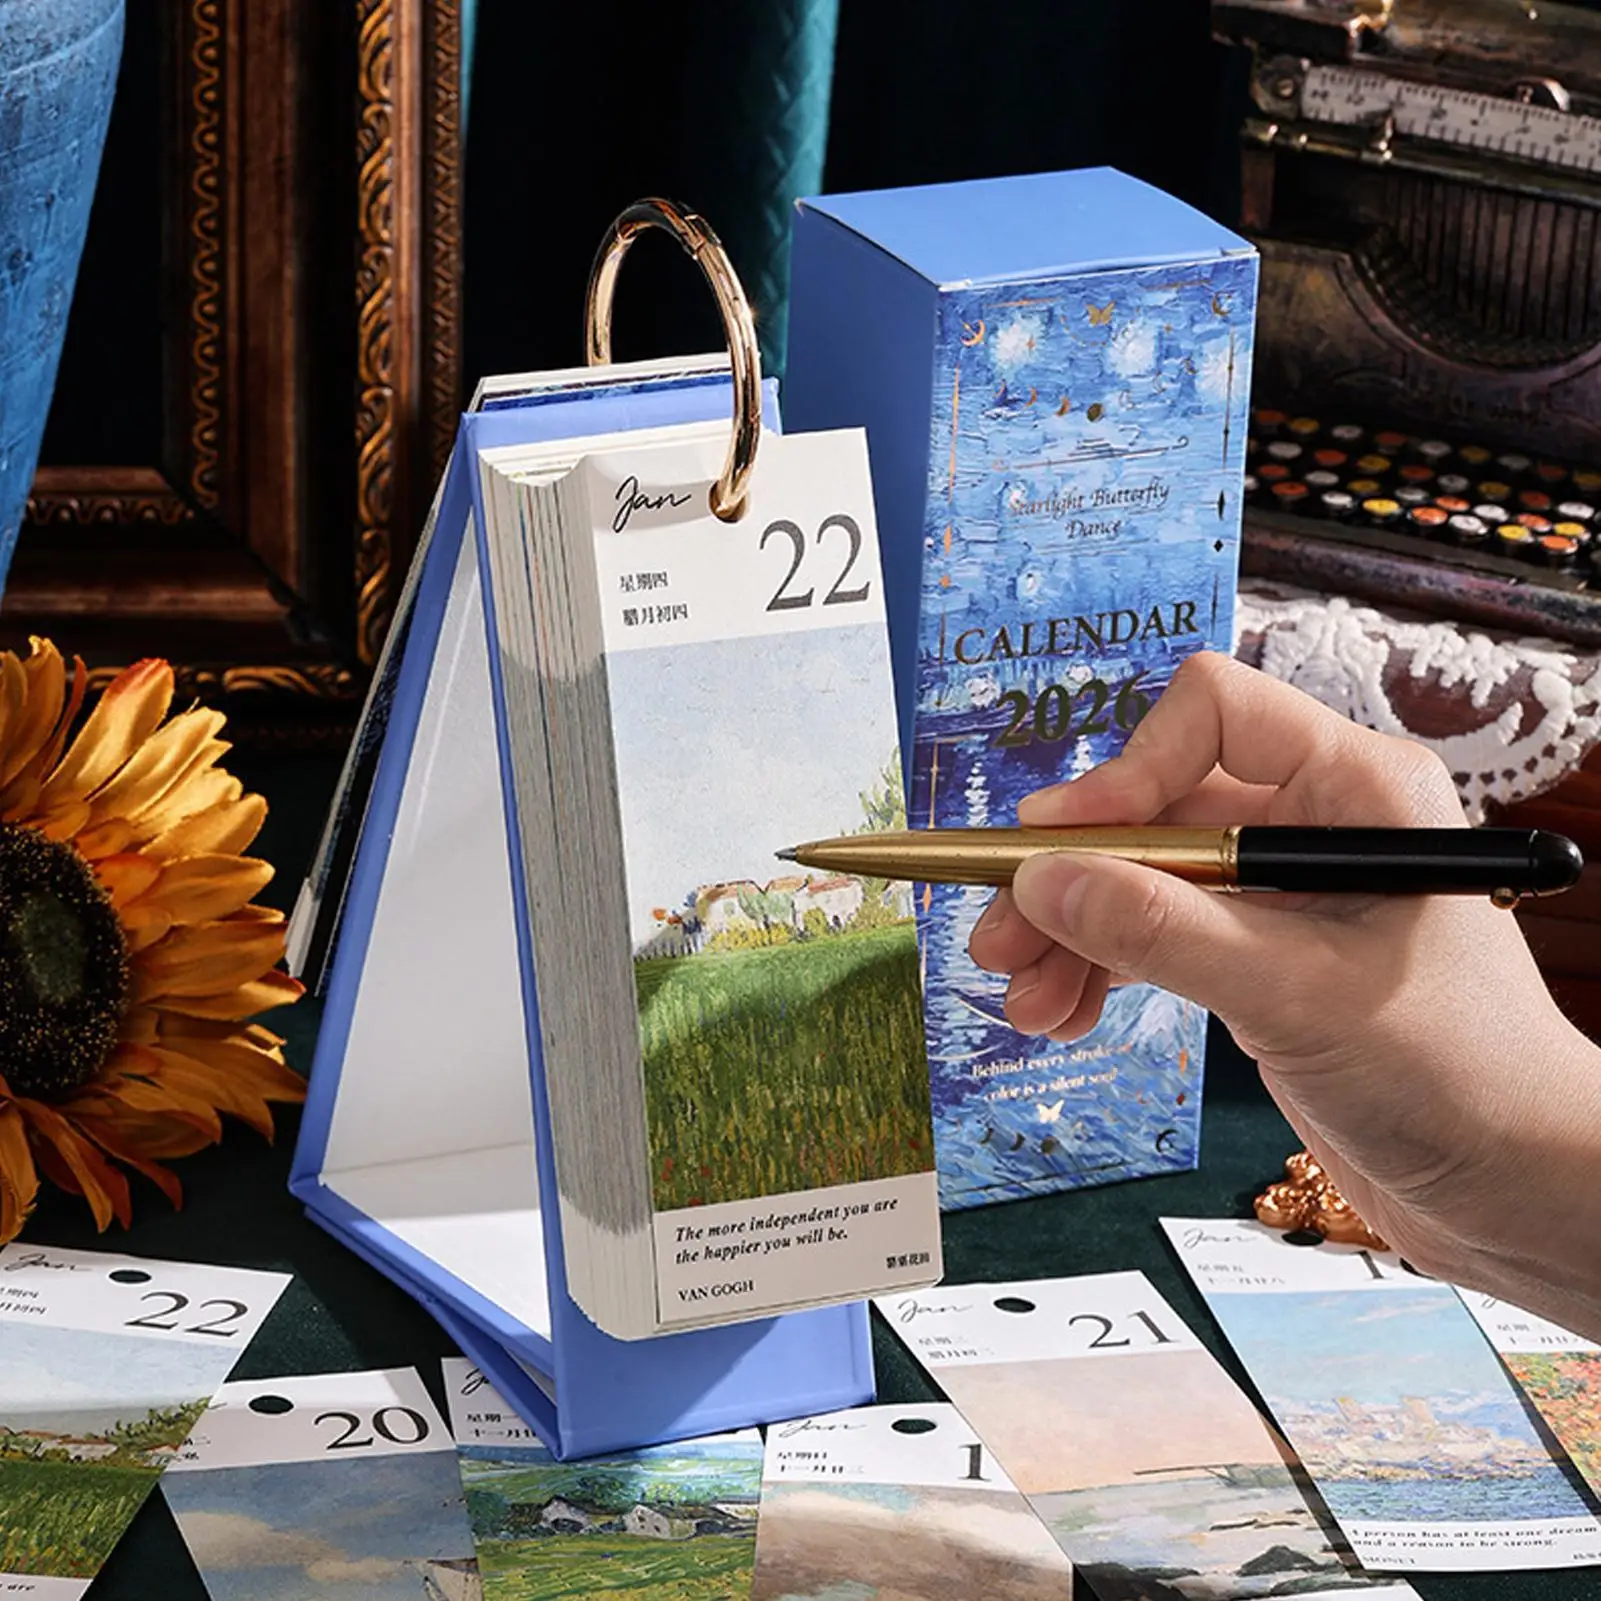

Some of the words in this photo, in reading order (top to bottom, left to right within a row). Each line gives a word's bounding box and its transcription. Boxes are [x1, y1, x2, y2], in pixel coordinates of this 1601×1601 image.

[613, 475, 692, 533] Jan
[1090, 475, 1170, 508] Butterfly
[1065, 518, 1123, 541] Dance
[759, 513, 871, 612] 22
[953, 600, 1199, 665] CALENDAR
[993, 670, 1151, 748] 2026
[972, 1056, 1024, 1078] Behind
[1027, 1053, 1065, 1071] every
[1023, 1083, 1036, 1096] is
[1037, 1083, 1047, 1094] a
[1050, 1075, 1085, 1092] silent
[676, 1226, 703, 1242] The
[707, 1222, 745, 1237] more
[749, 1206, 840, 1233] independent
[841, 1202, 870, 1221] you
[873, 1198, 899, 1213] are
[675, 1249, 701, 1265] the
[703, 1242, 762, 1261] happier
[764, 1237, 792, 1255] you
[795, 1228, 825, 1245] will
[827, 1225, 849, 1241] be.
[677, 1286, 709, 1302] VAN
[711, 1279, 755, 1298] GOGH
[123, 1291, 249, 1338] 22
[897, 1299, 974, 1323] Jan
[1068, 1310, 1182, 1349] 21
[314, 1407, 430, 1450] 20
[7, 1583, 36, 1592] are
